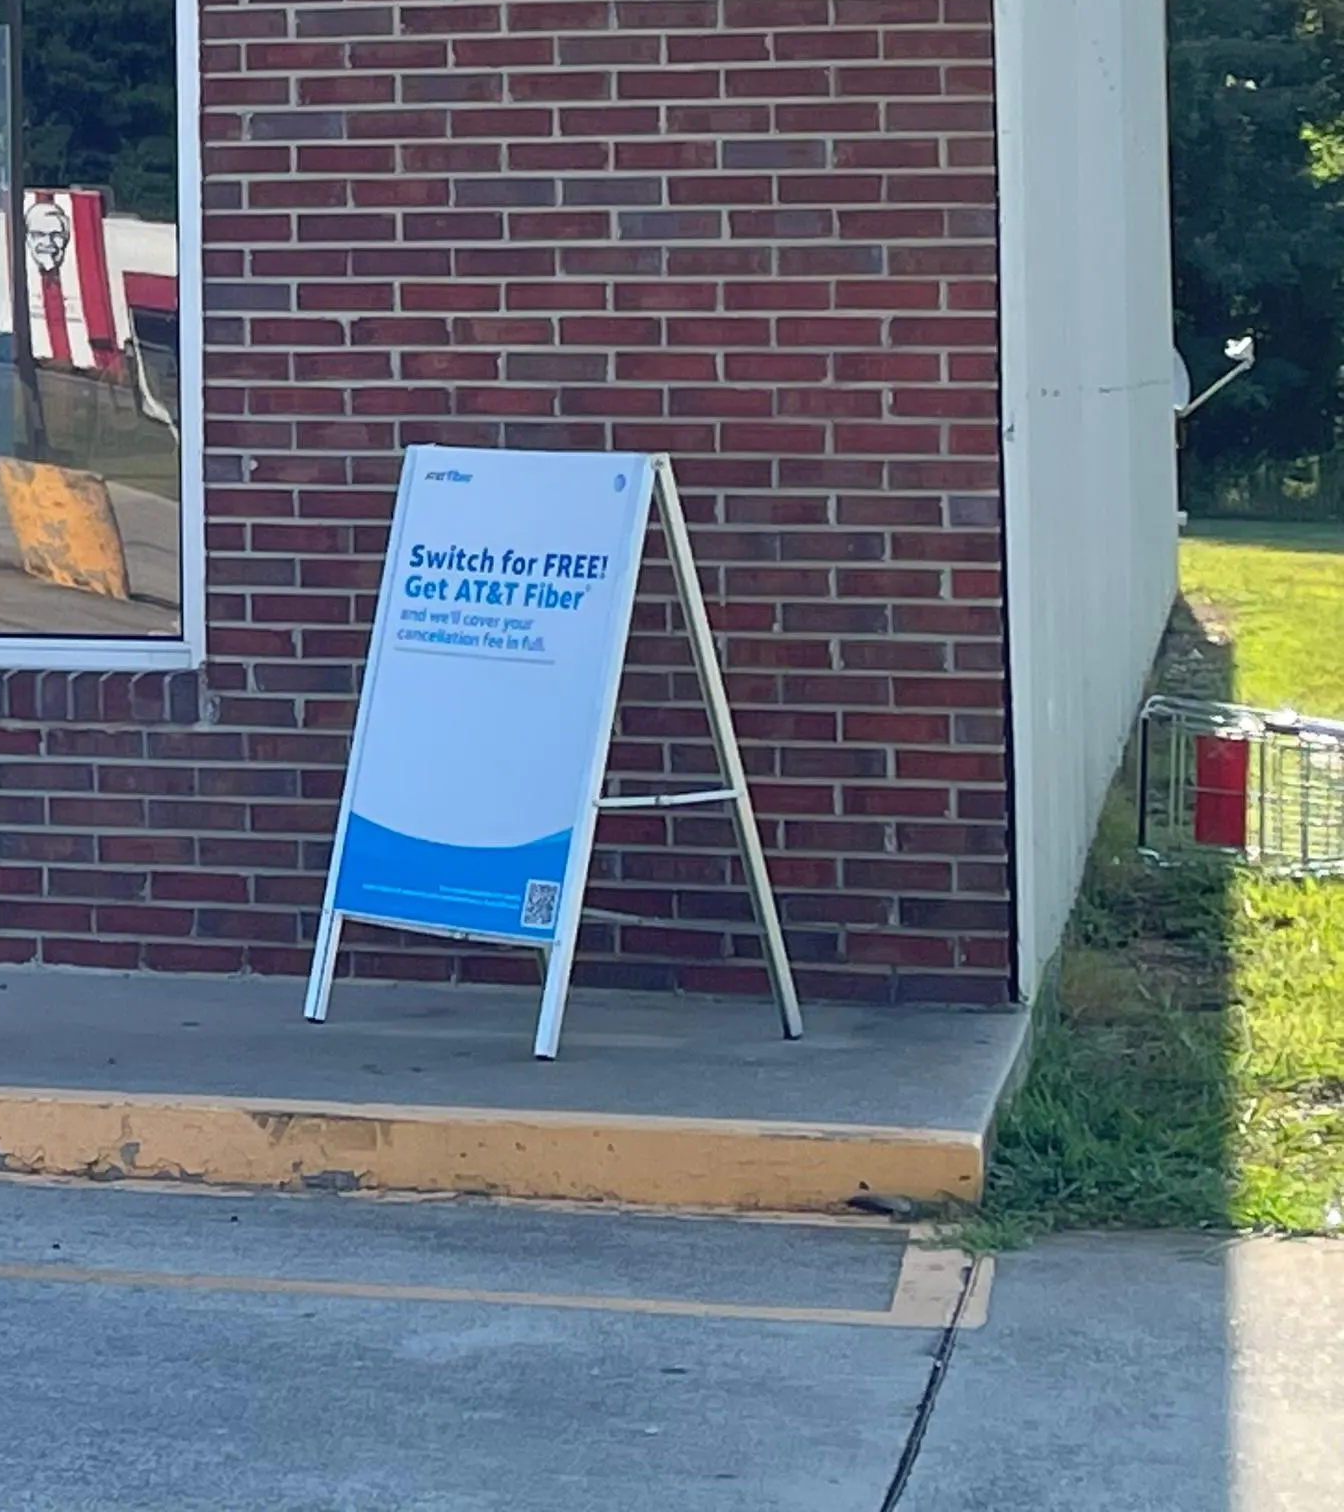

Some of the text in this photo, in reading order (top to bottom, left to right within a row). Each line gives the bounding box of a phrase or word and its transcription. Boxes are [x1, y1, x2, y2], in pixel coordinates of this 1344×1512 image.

[409, 544, 608, 580] Switch for FREE!
[405, 575, 449, 601] Get
[454, 578, 519, 606] AT&T
[400, 608, 535, 633] and we'll cover your
[397, 627, 479, 647] cancellation
[483, 632, 503, 649] fee
[506, 633, 519, 649] in
